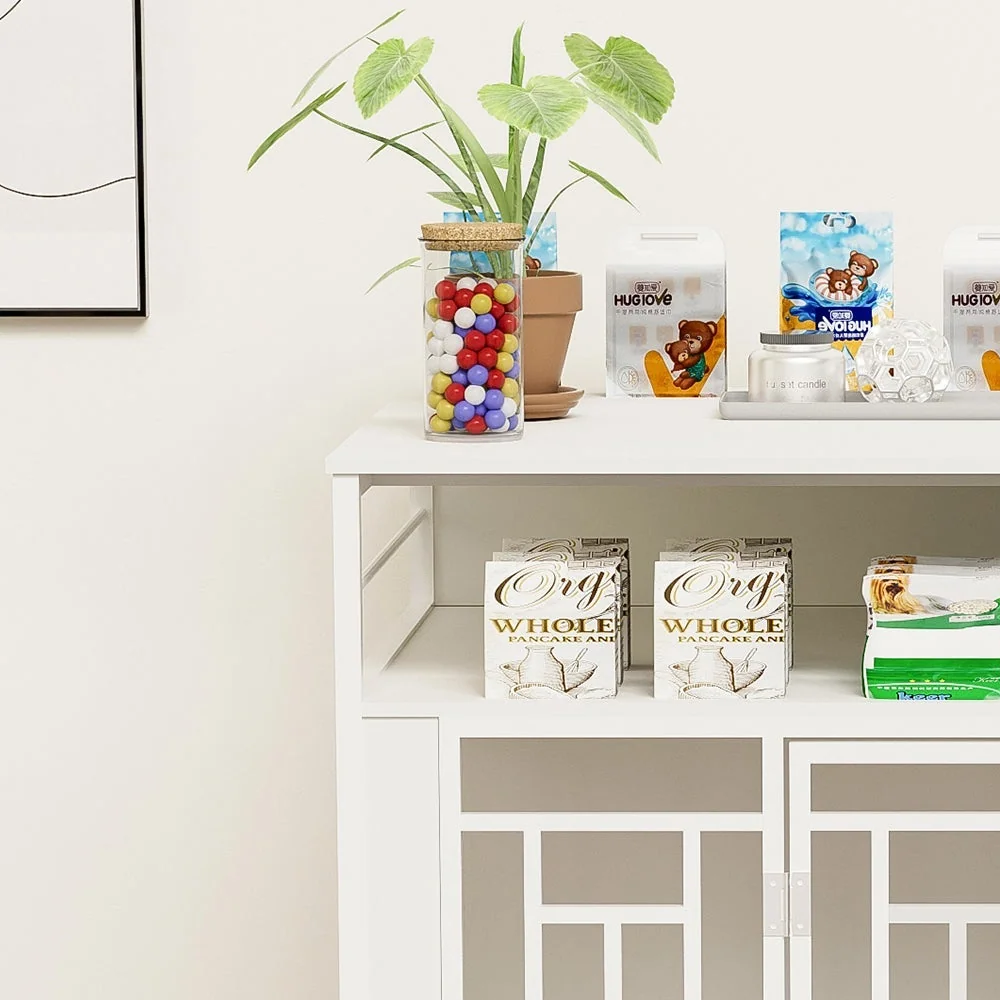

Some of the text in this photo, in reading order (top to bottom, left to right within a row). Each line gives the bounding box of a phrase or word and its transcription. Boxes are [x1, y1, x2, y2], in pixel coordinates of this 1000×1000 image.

[797, 379, 827, 389] candle
[495, 563, 617, 611] Org
[664, 563, 786, 611] Org
[490, 618, 614, 633] WHOLE
[660, 618, 784, 633] WHOLE
